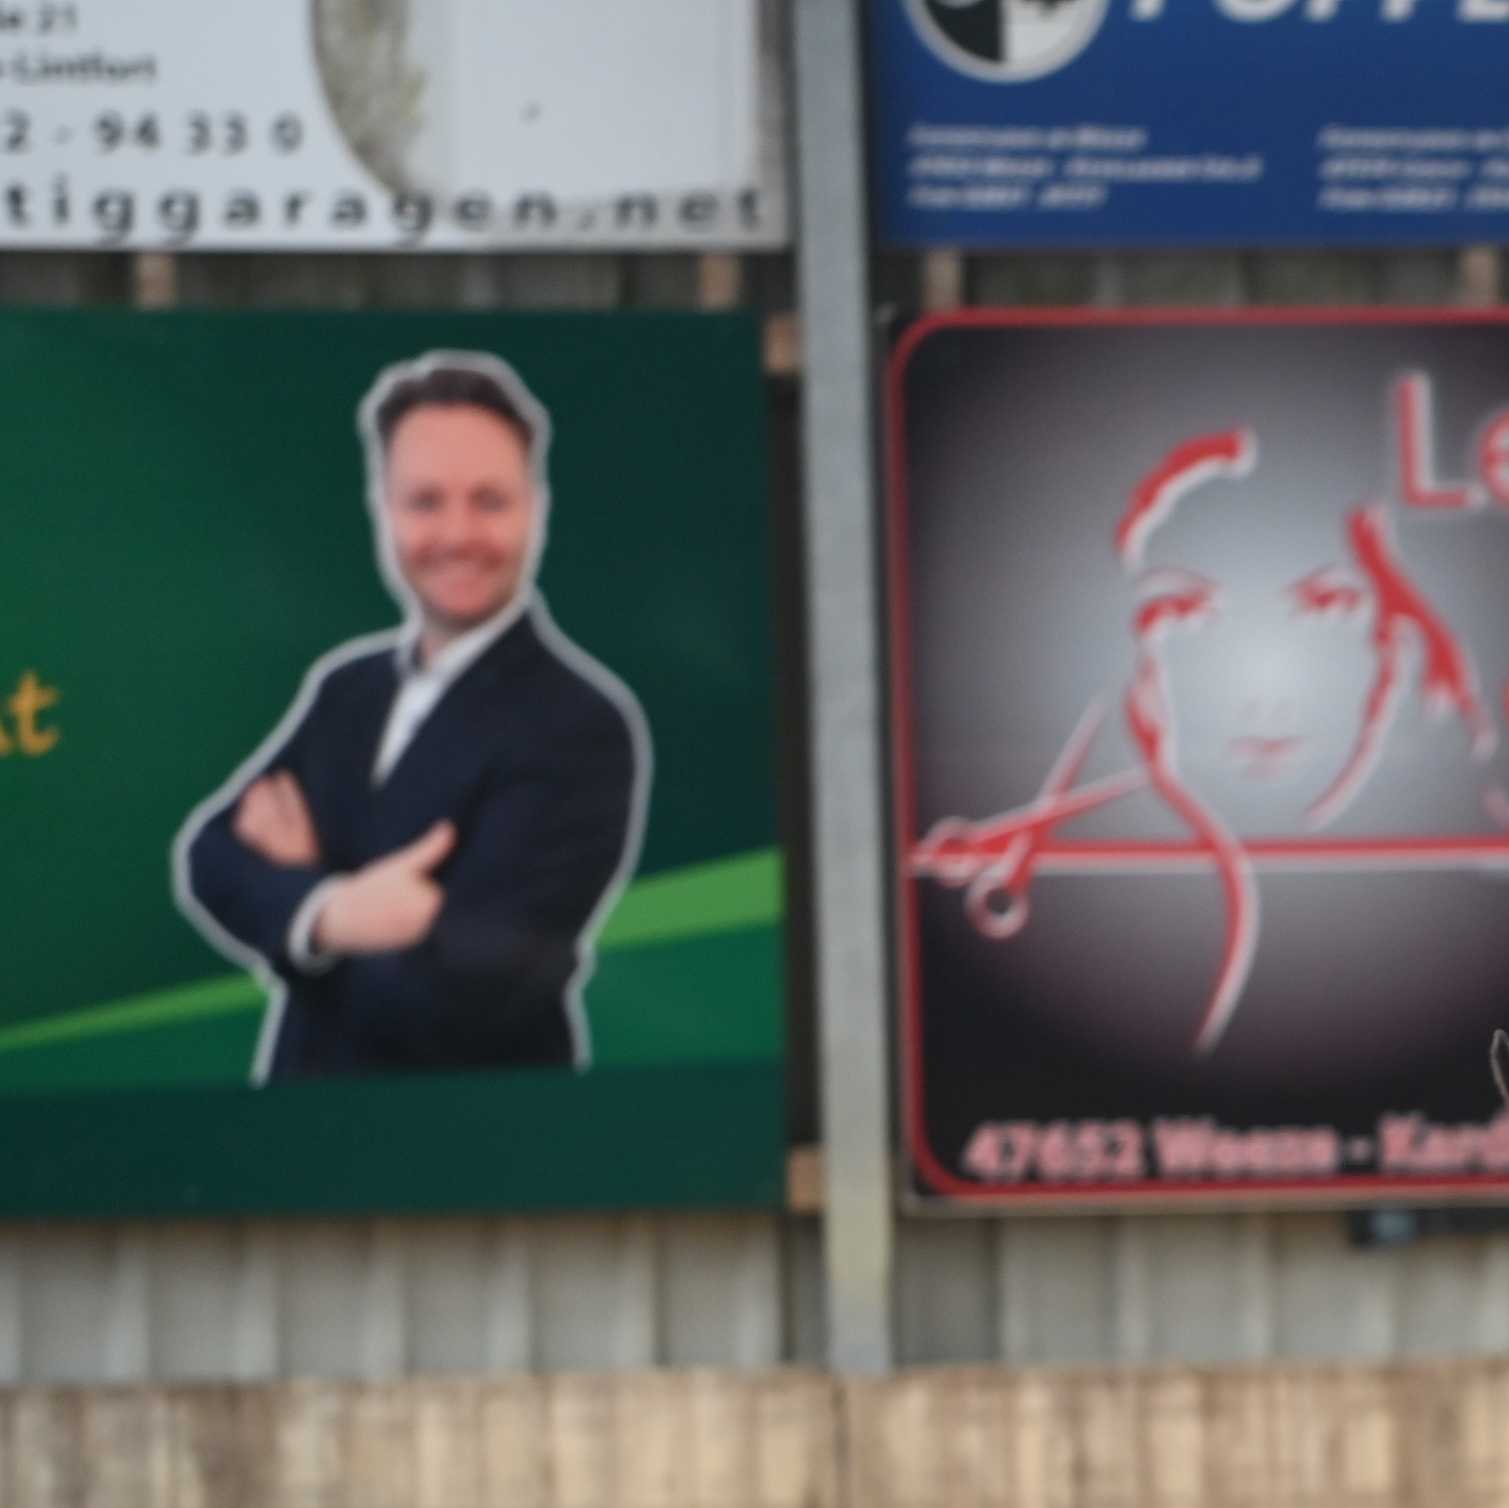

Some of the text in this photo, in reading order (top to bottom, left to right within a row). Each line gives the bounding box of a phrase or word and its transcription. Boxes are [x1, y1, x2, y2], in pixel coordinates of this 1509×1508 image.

[92, 108, 160, 155] 94
[187, 108, 250, 156] 33
[270, 108, 305, 155] 0
[1150, 1112, 1341, 1178] Weeze
